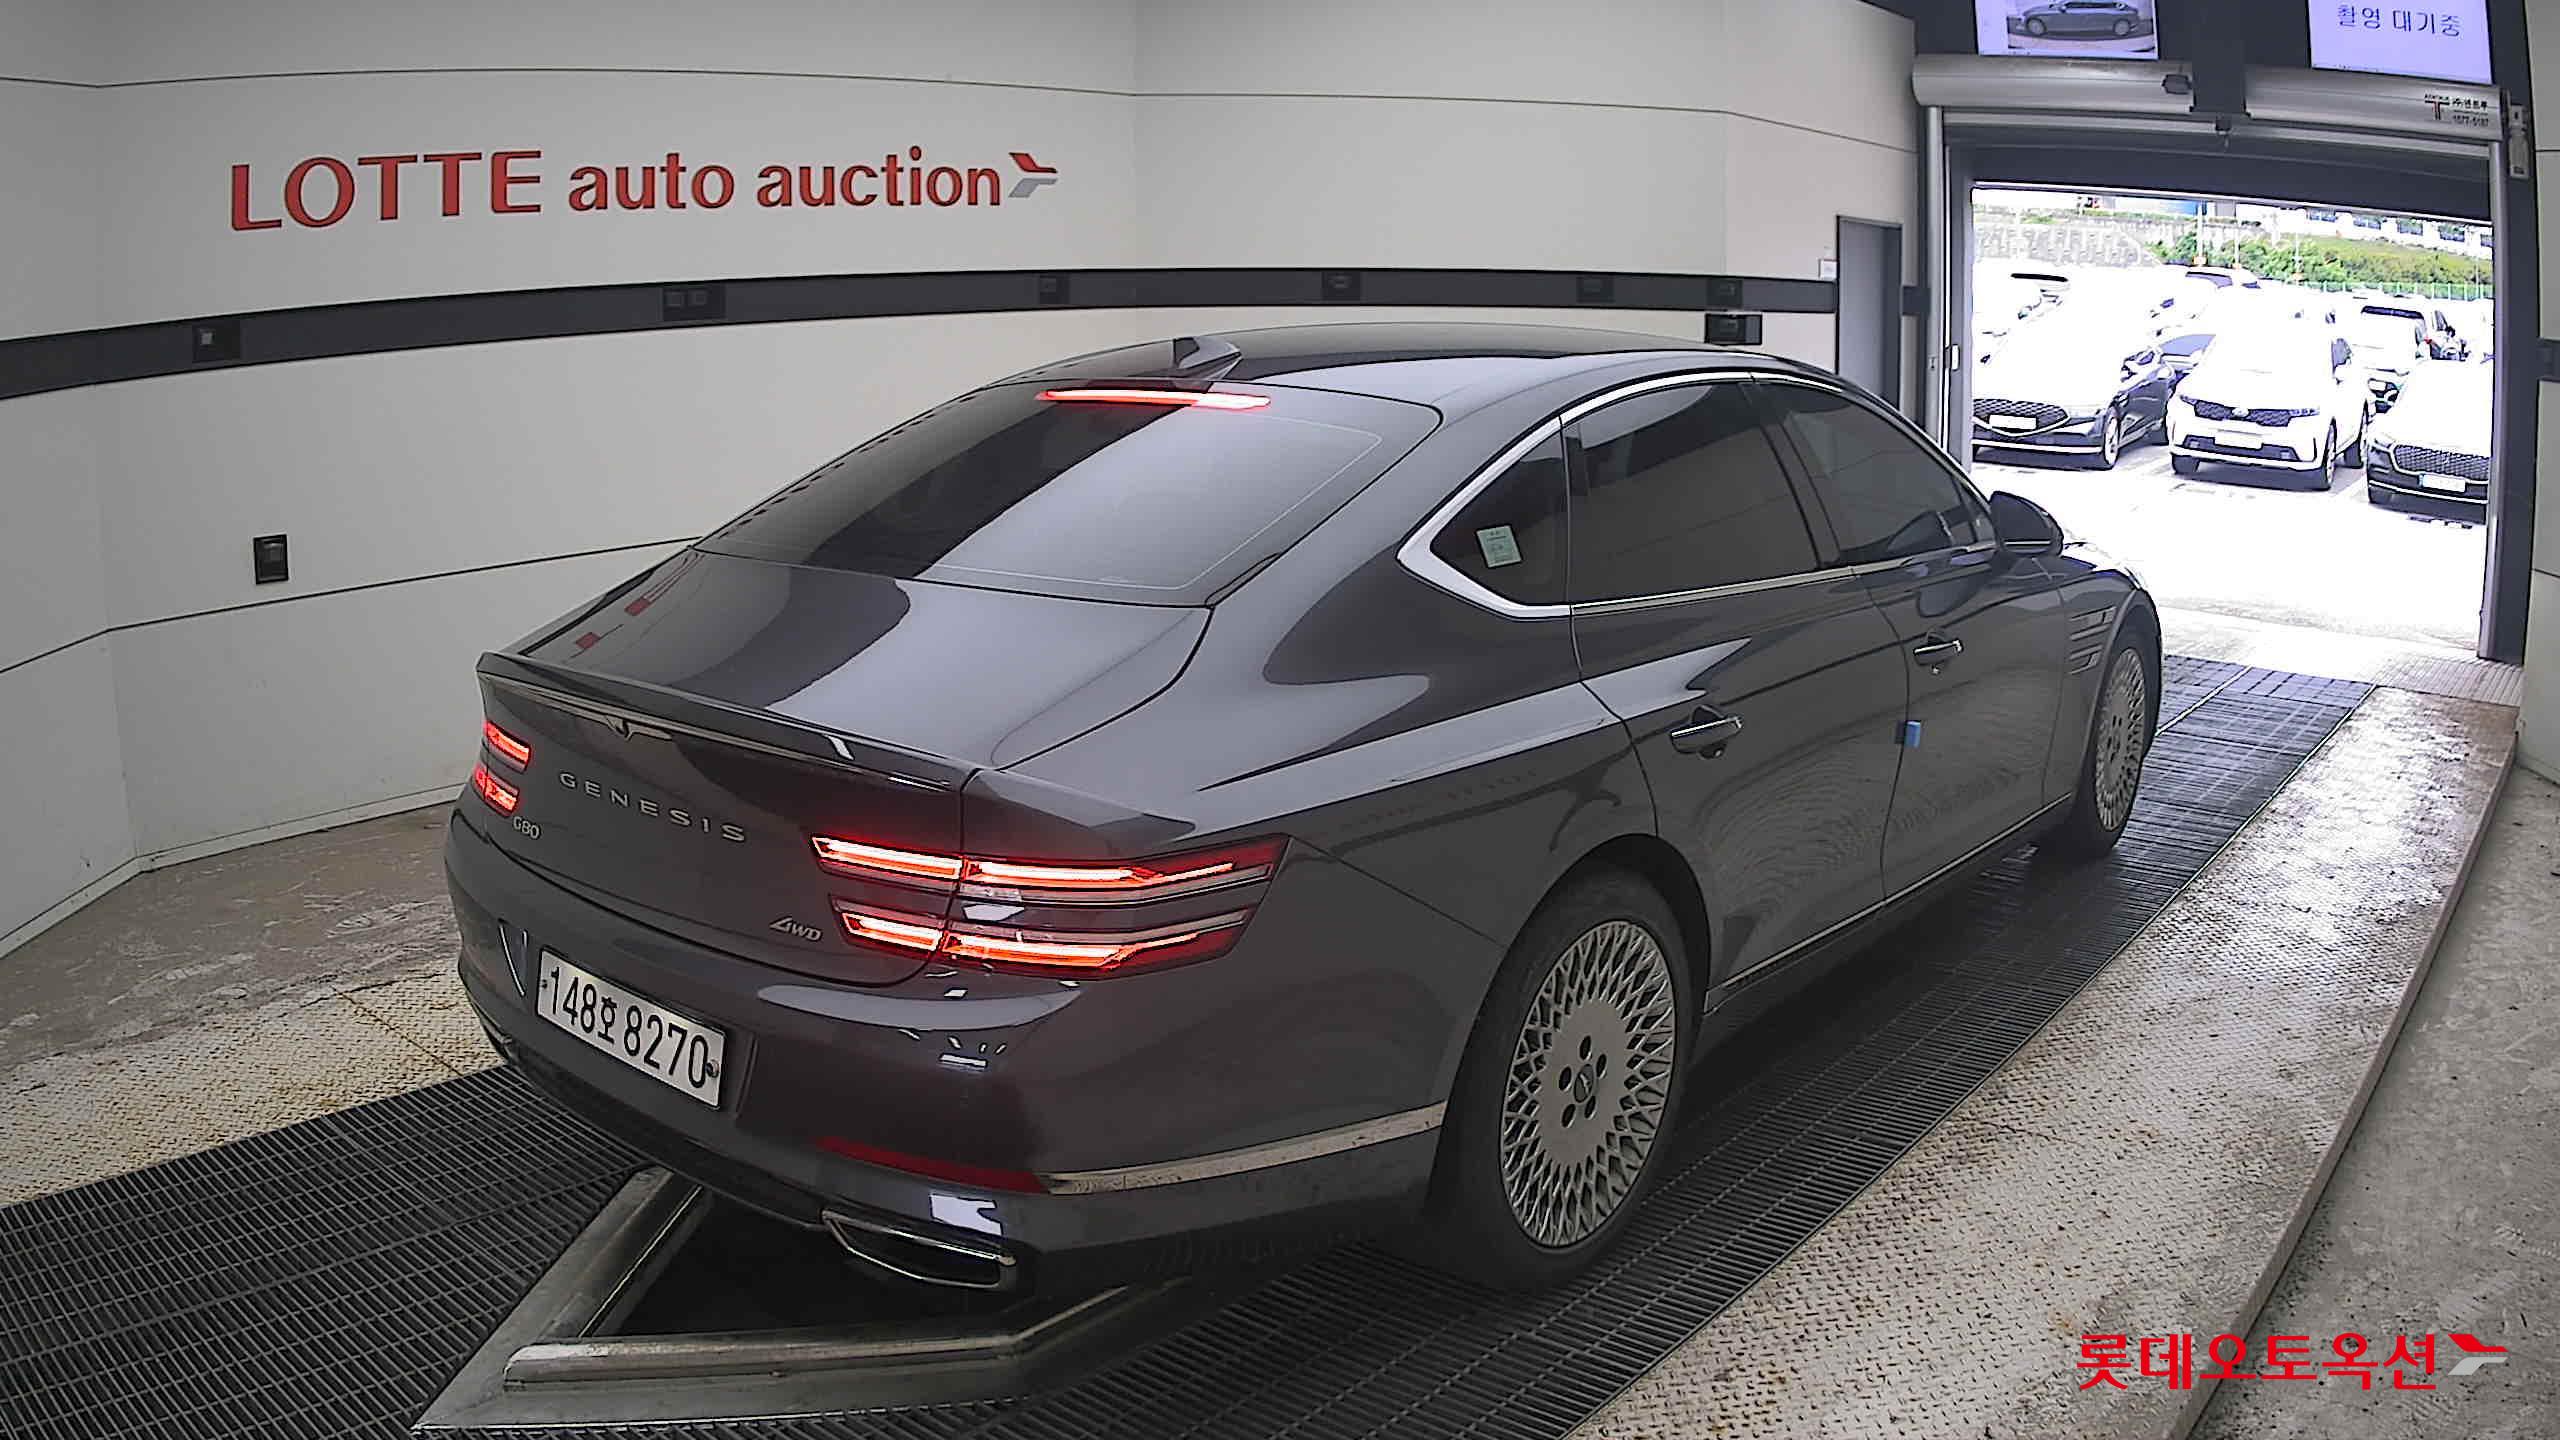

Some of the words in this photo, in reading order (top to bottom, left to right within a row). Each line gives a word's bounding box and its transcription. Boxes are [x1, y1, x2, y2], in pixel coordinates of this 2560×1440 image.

[2338, 5, 2381, 31] 촬영
[2392, 10, 2461, 37] 대기중
[231, 150, 542, 231] LOTTE
[567, 152, 734, 209] auto
[756, 146, 1000, 206] auction
[560, 773, 745, 841] GENESIS
[513, 816, 540, 839] G80
[769, 917, 821, 941] 4WD
